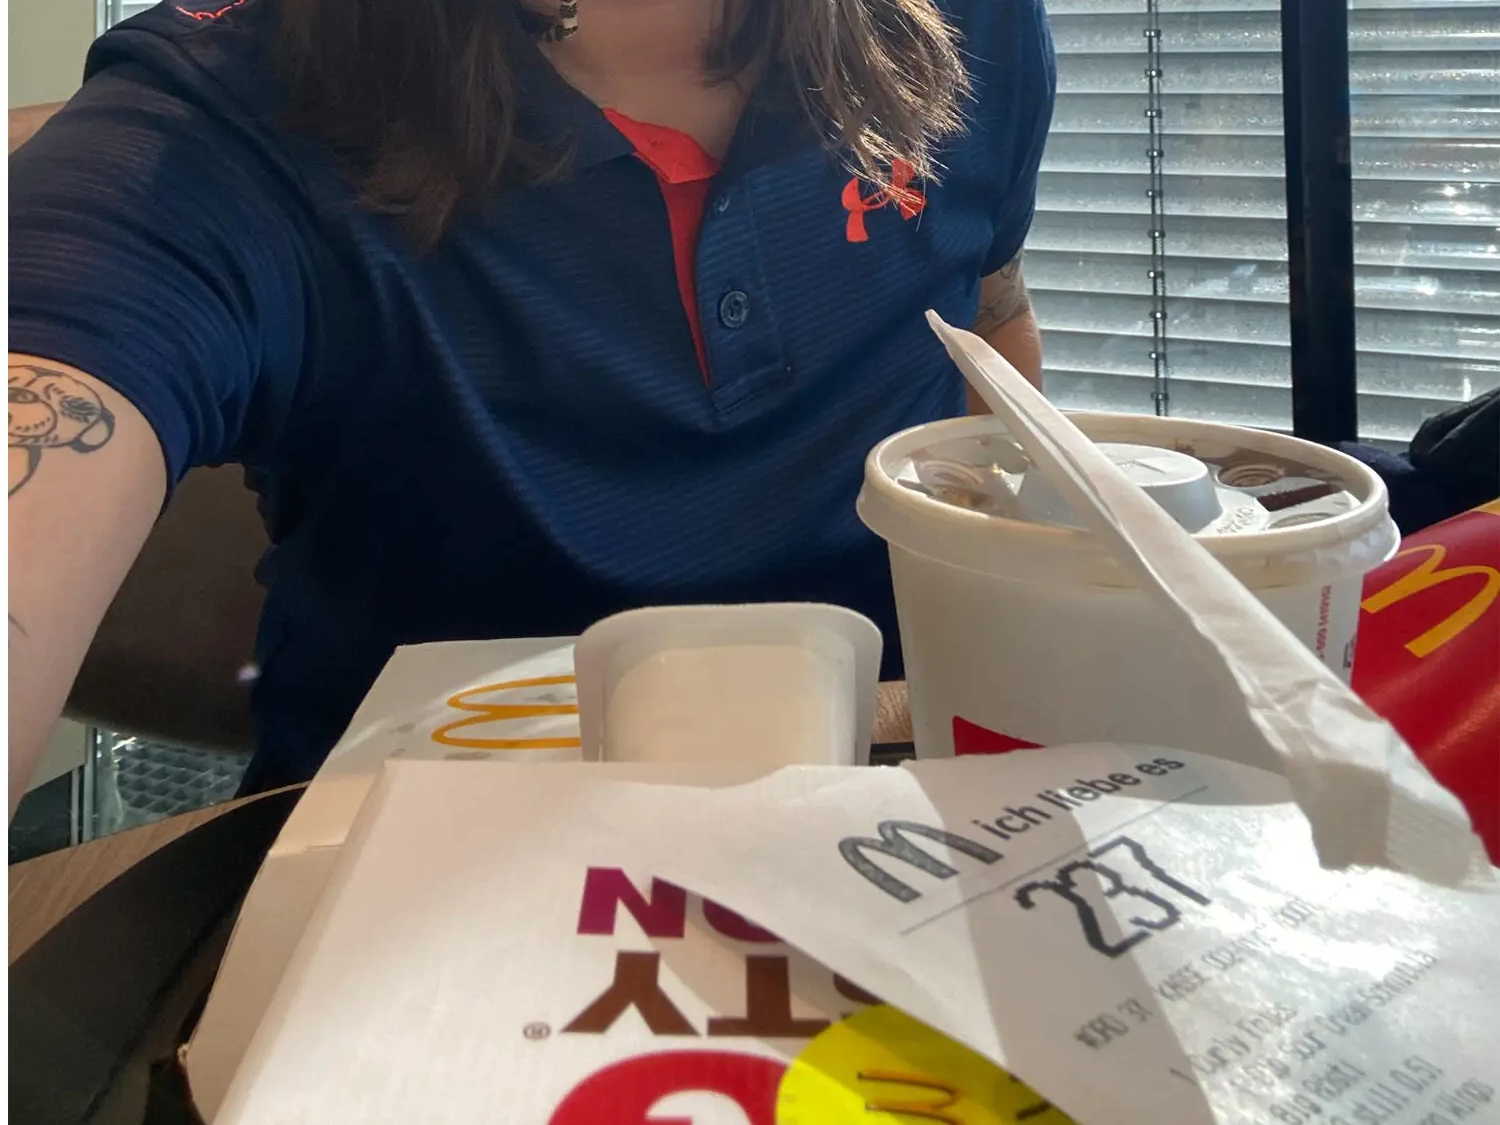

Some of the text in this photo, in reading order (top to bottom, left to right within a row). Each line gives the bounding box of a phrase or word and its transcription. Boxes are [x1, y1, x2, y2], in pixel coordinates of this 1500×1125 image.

[972, 801, 1053, 842] ich
[1037, 769, 1142, 812] liebe
[1135, 756, 1186, 778] es
[1013, 834, 1211, 959] 237
